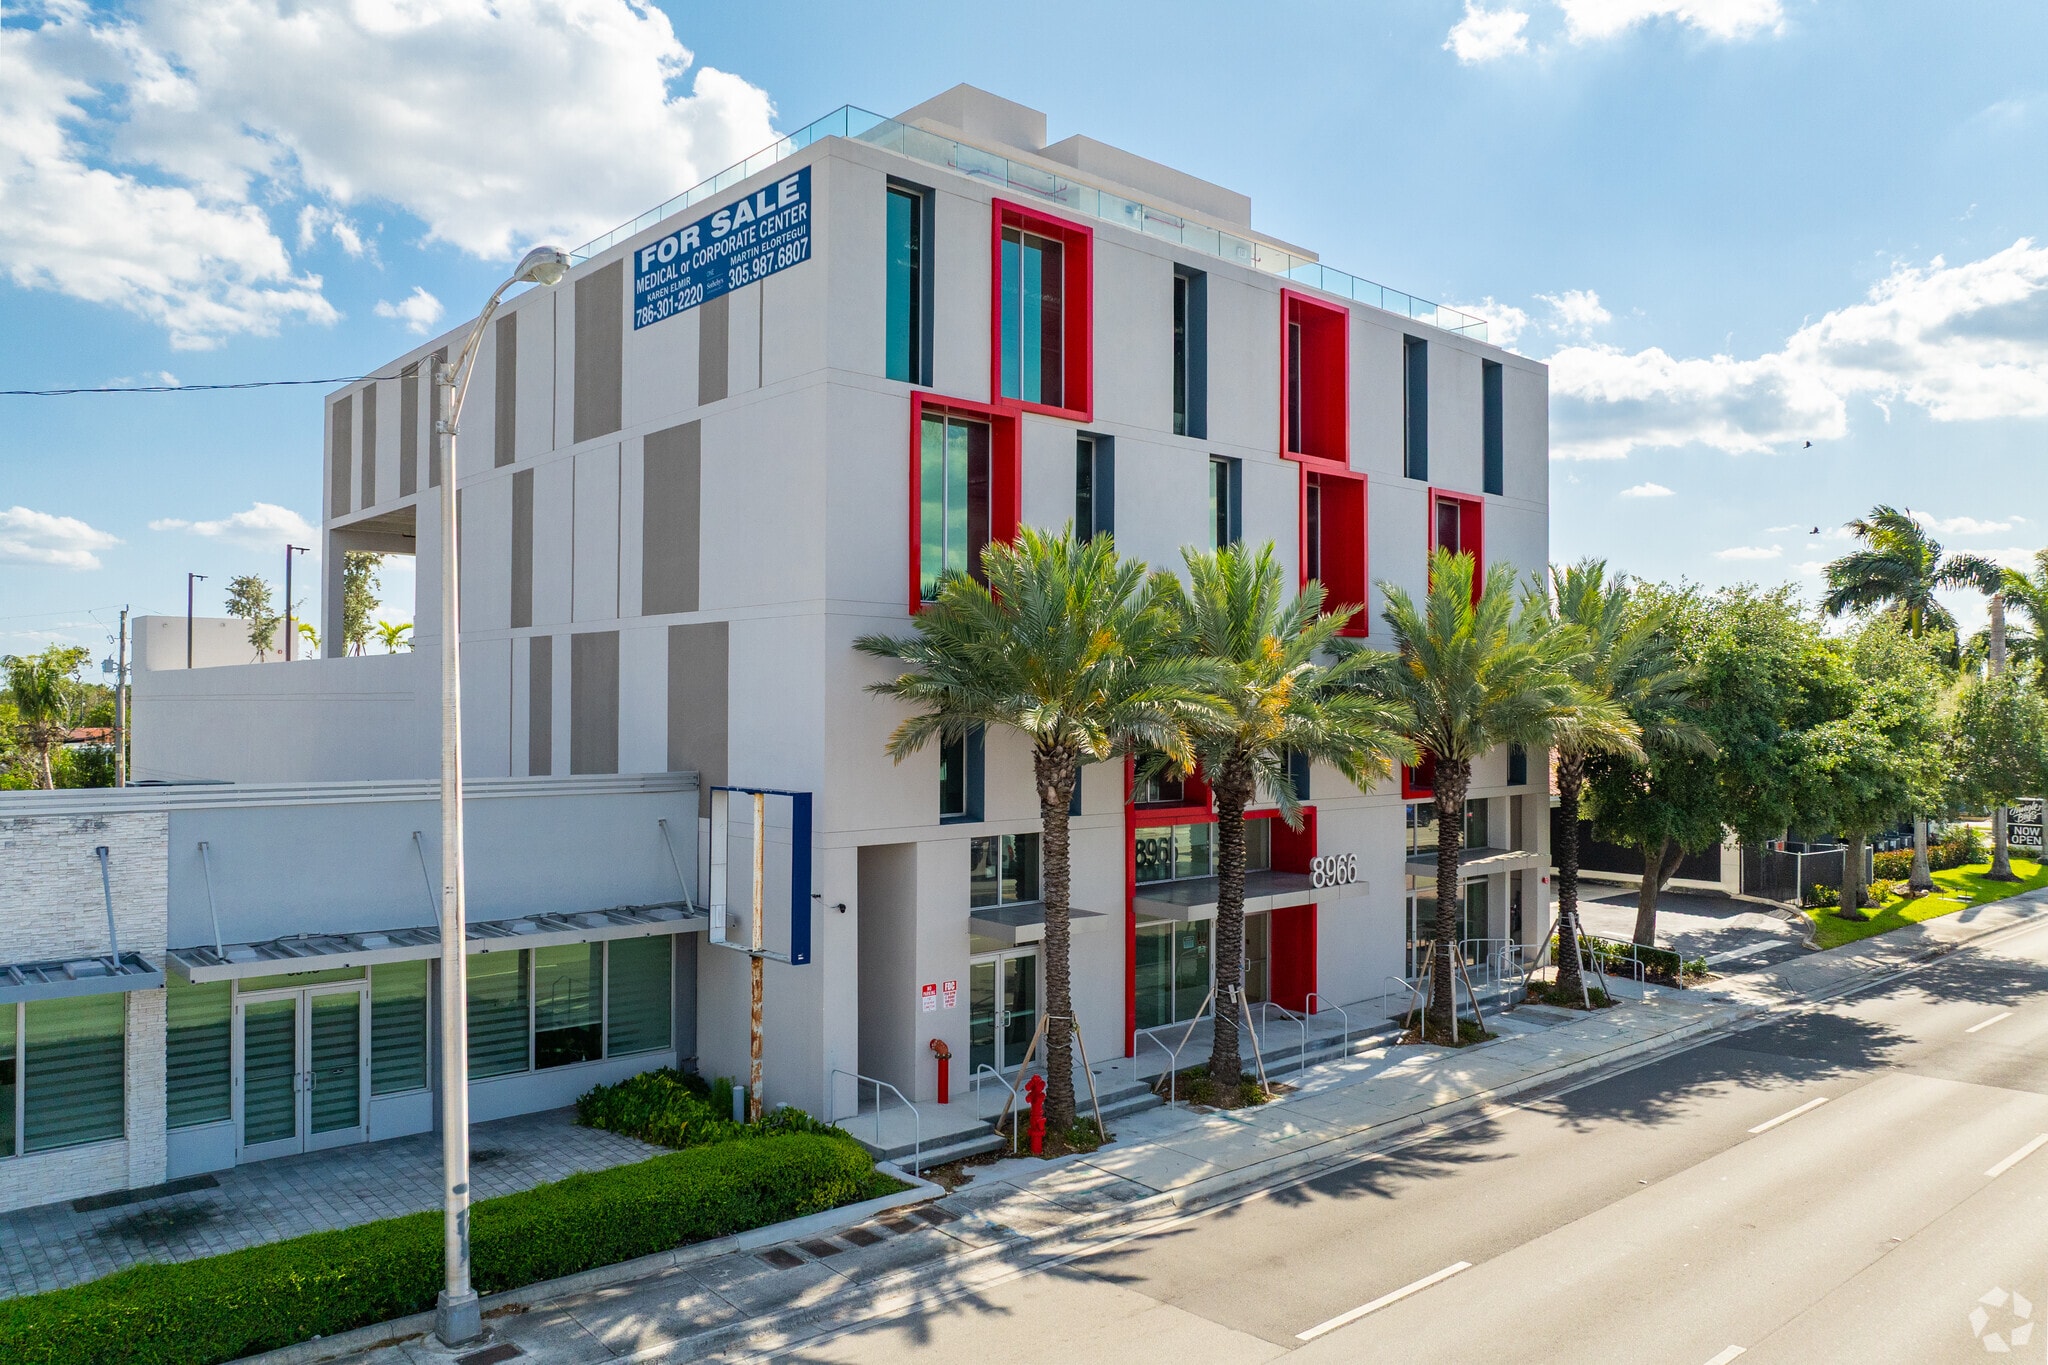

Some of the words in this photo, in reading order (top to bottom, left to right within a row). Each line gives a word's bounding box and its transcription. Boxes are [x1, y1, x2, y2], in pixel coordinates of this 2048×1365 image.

[641, 225, 700, 273] FOR
[711, 173, 800, 238] SALE
[636, 263, 678, 295] MEDICAL
[680, 260, 691, 275] or
[692, 224, 757, 269] CORPORATE
[760, 202, 807, 239] CENTER
[728, 236, 809, 289] 305.987.6807
[730, 246, 760, 266] MARTIN
[761, 224, 806, 252] ELORTEGUI
[636, 283, 704, 328] 786-301-2220
[647, 286, 669, 303] KAREN
[670, 276, 691, 293] ELMIR
[2011, 834, 2042, 845] OPEN
[2013, 826, 2041, 836] NOW
[1310, 853, 1358, 889] 8966
